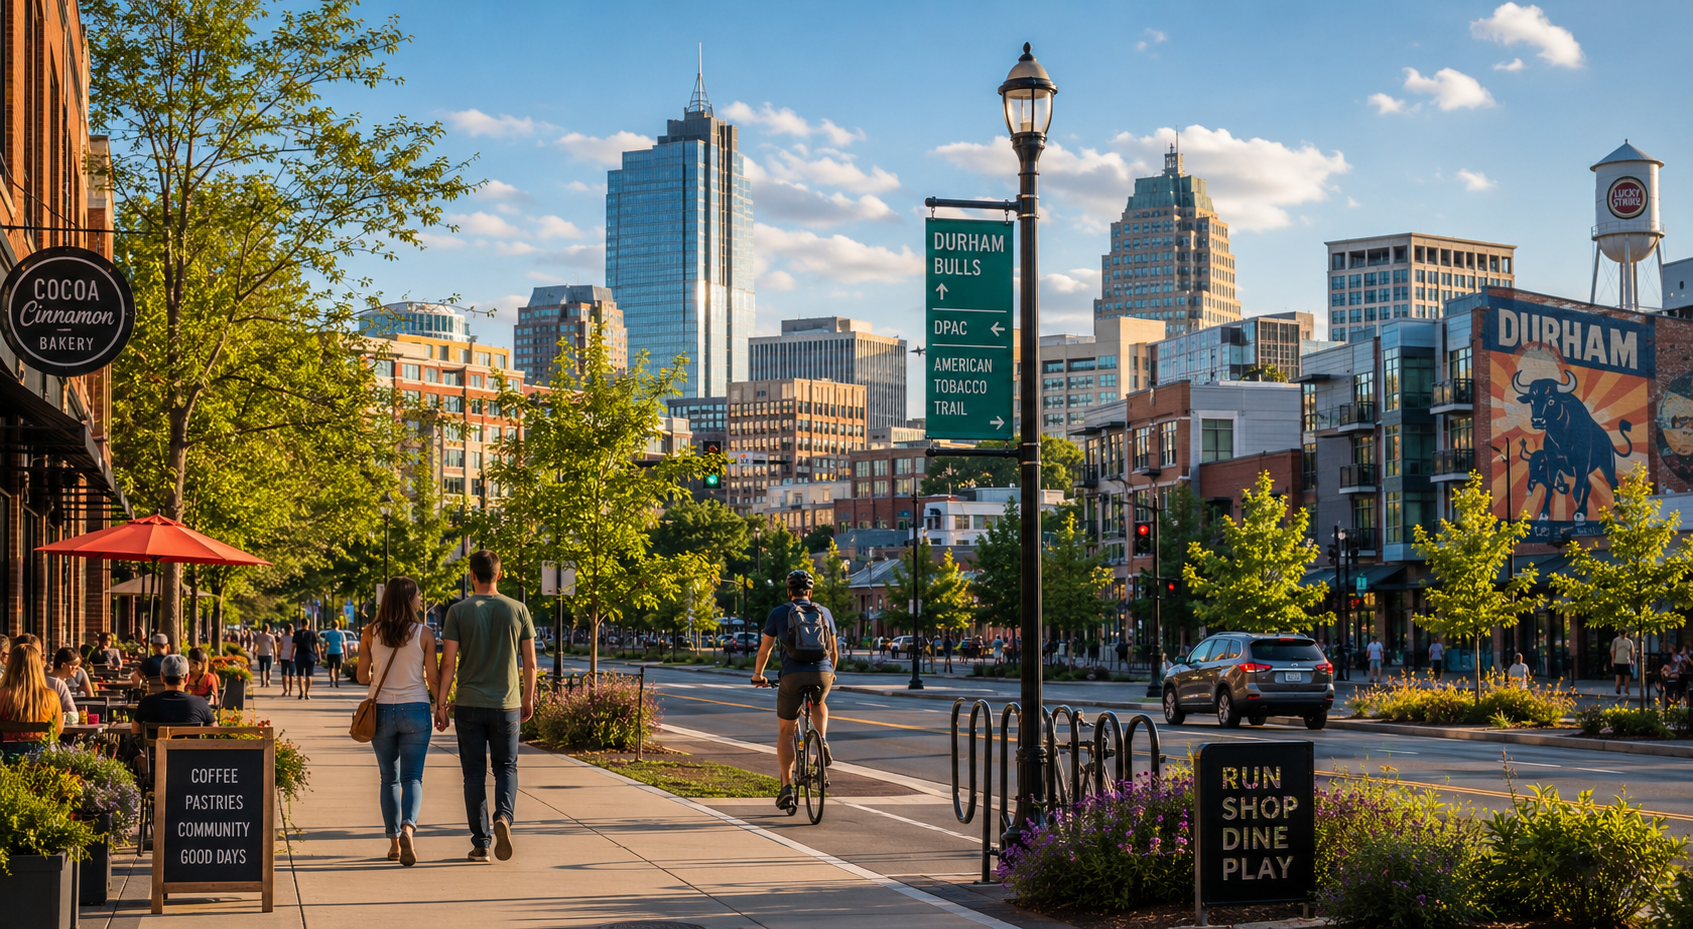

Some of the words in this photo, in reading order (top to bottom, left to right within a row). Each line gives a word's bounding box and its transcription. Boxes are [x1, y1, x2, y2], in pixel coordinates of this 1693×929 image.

[1614, 188, 1640, 198] LUCKY
[934, 231, 1004, 253] DURHAM
[934, 257, 981, 276] BULLS
[34, 278, 100, 301] COCOA
[20, 300, 115, 327] Cinnamon
[934, 320, 968, 336] DPAC
[40, 336, 94, 351] BAKERY
[1498, 308, 1638, 370] DURHAM
[934, 357, 993, 373] AMERICAN
[934, 379, 987, 395] TOBACCO
[934, 400, 968, 416] TRAIL
[191, 768, 239, 784] COFFEE
[1222, 766, 1282, 790] RUN
[185, 794, 244, 810] PASTRIES
[1222, 796, 1299, 821] SHOP
[177, 821, 250, 838] COMMUNITY
[1222, 826, 1289, 851] DINE
[180, 849, 213, 865] GOOD
[216, 849, 247, 865] DAYS
[1222, 855, 1294, 881] PLAY
